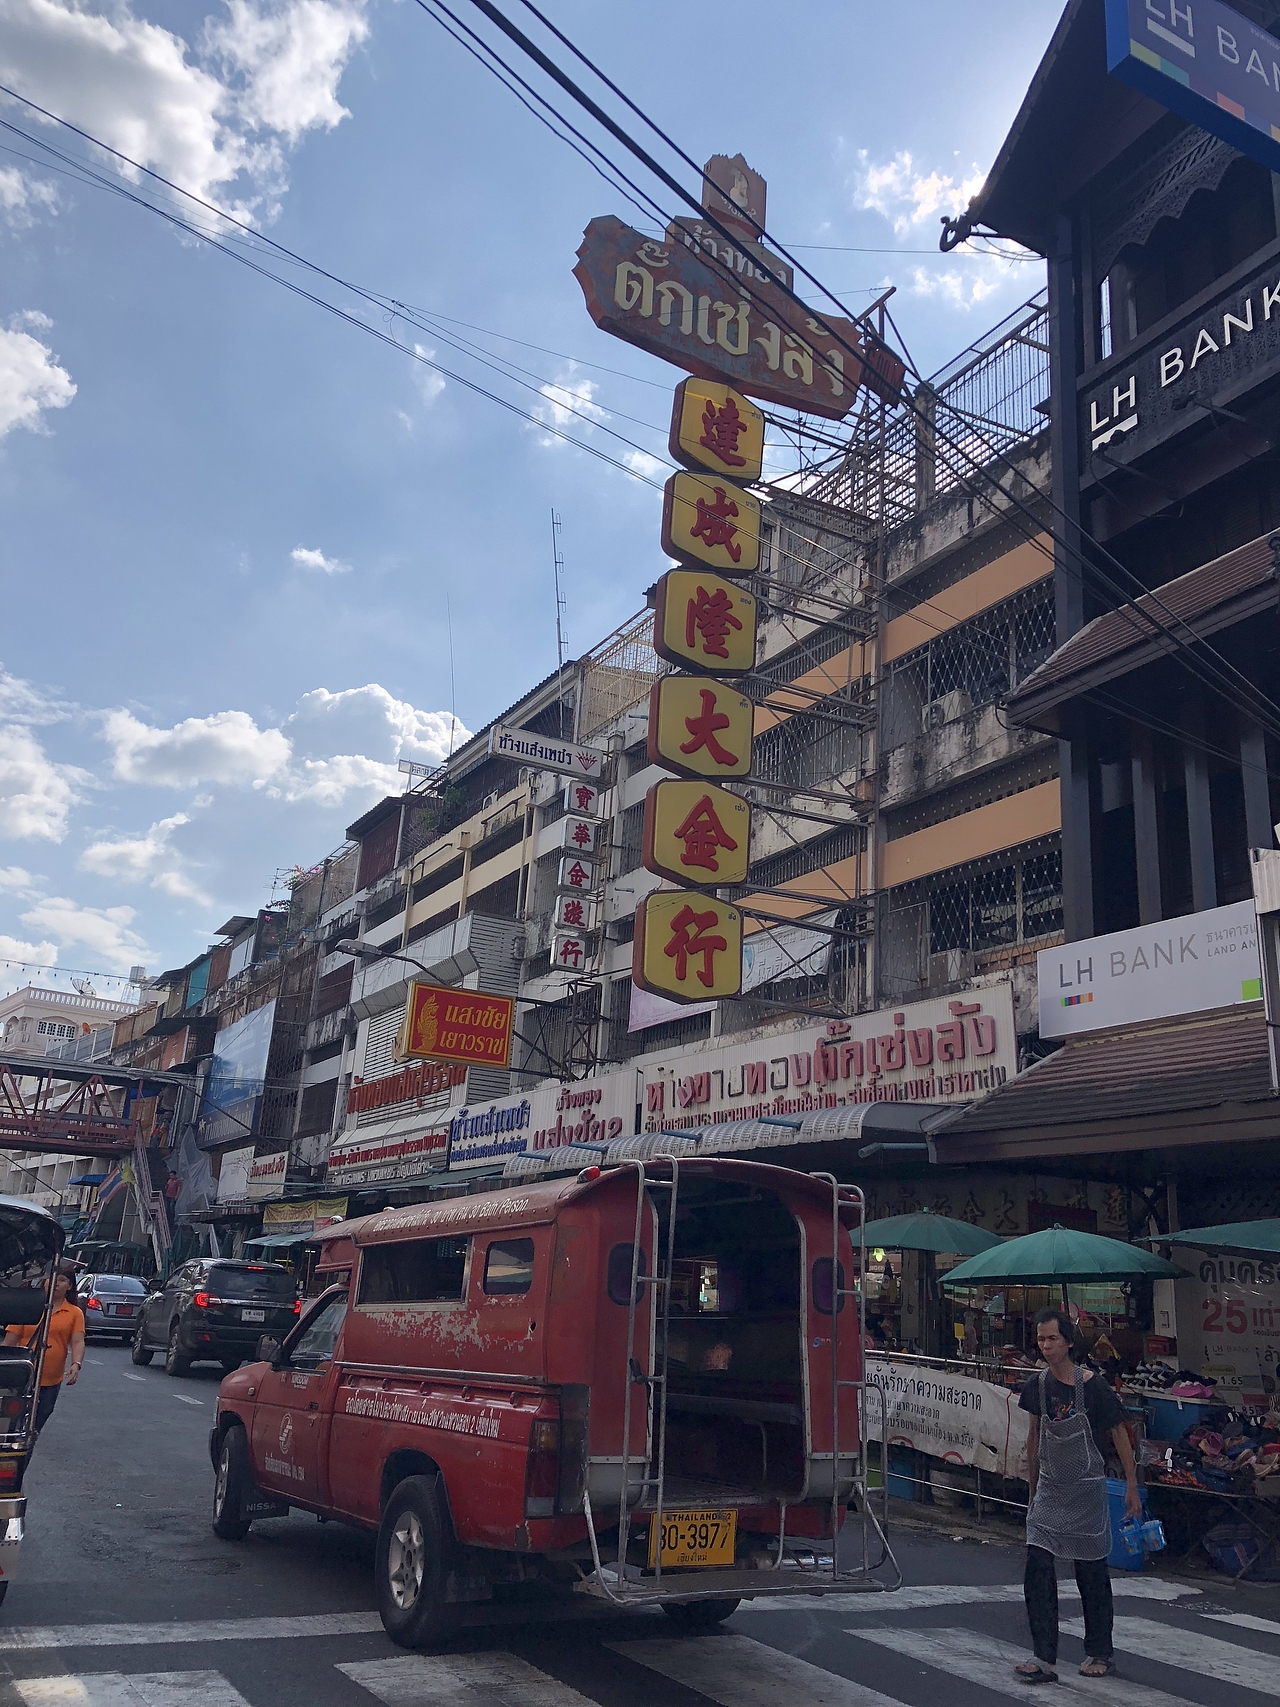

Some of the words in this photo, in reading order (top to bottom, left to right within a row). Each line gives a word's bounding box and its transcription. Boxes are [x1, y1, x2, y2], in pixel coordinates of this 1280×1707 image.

[1217, 25, 1280, 92] BA
[1090, 375, 1137, 432] LH
[1159, 278, 1280, 388] BANK
[1059, 956, 1093, 988] LH
[1110, 933, 1199, 978] BANK
[1207, 943, 1237, 957] LAND
[444, 1005, 508, 1030] แสงชัย
[440, 1030, 505, 1056] เยาวราช
[1200, 1252, 1280, 1293] คุ้มคร
[1202, 1298, 1248, 1334] 25
[1220, 1376, 1243, 1386] 1.65
[672, 1512, 718, 1522] THAILAND
